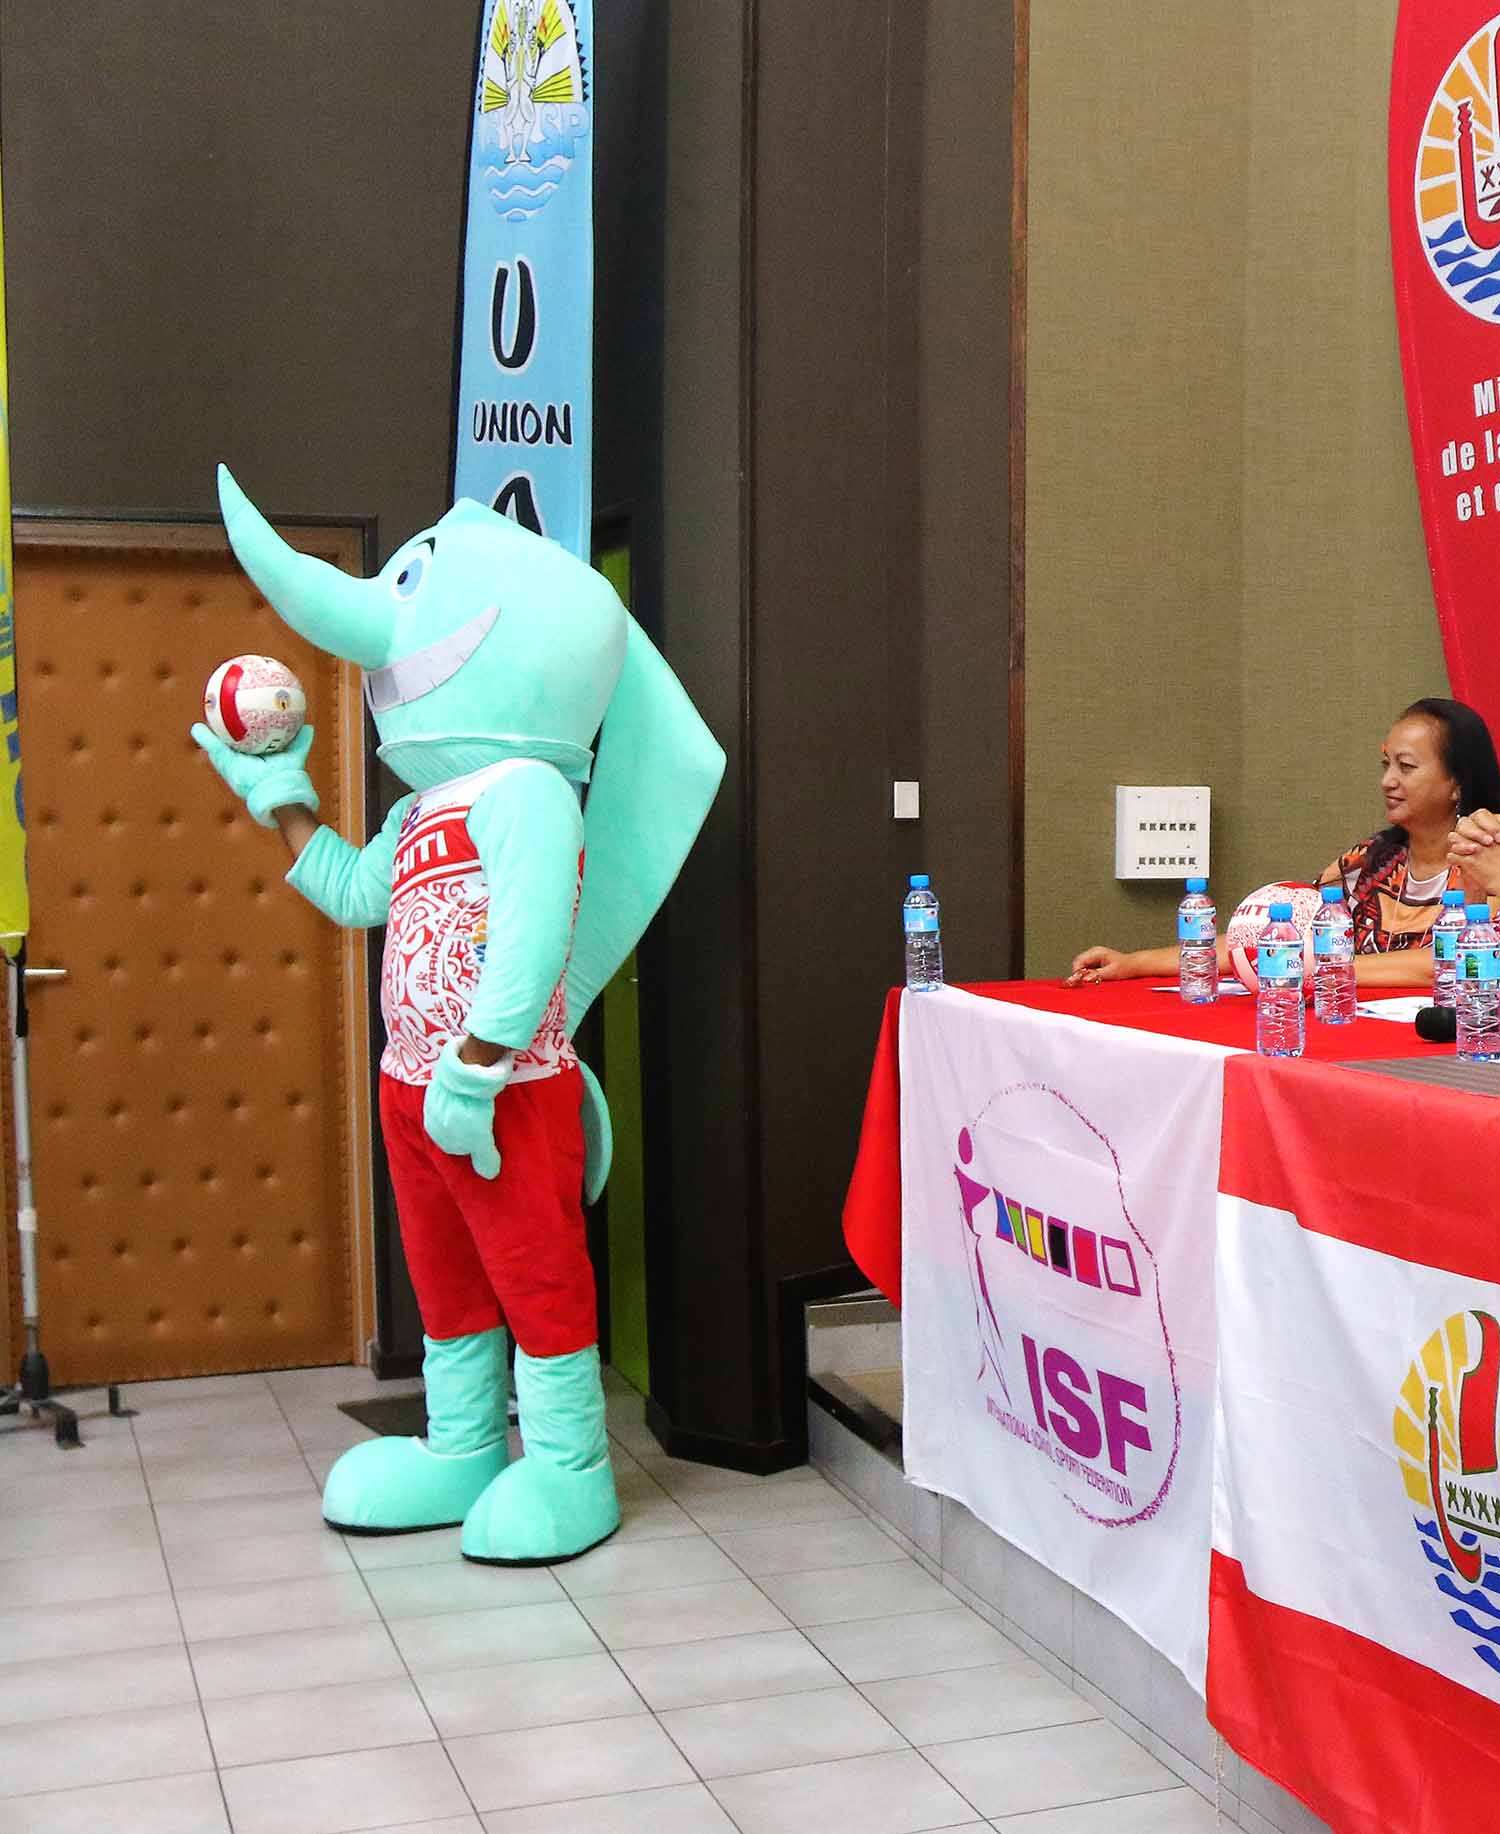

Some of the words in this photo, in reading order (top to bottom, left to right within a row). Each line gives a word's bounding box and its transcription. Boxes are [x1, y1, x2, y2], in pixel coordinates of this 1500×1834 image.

[491, 260, 536, 370] U
[473, 402, 572, 445] UNION
[1441, 440, 1476, 477] de
[1456, 485, 1486, 522] et
[394, 829, 449, 882] HITI
[1021, 1333, 1153, 1476] ISF
